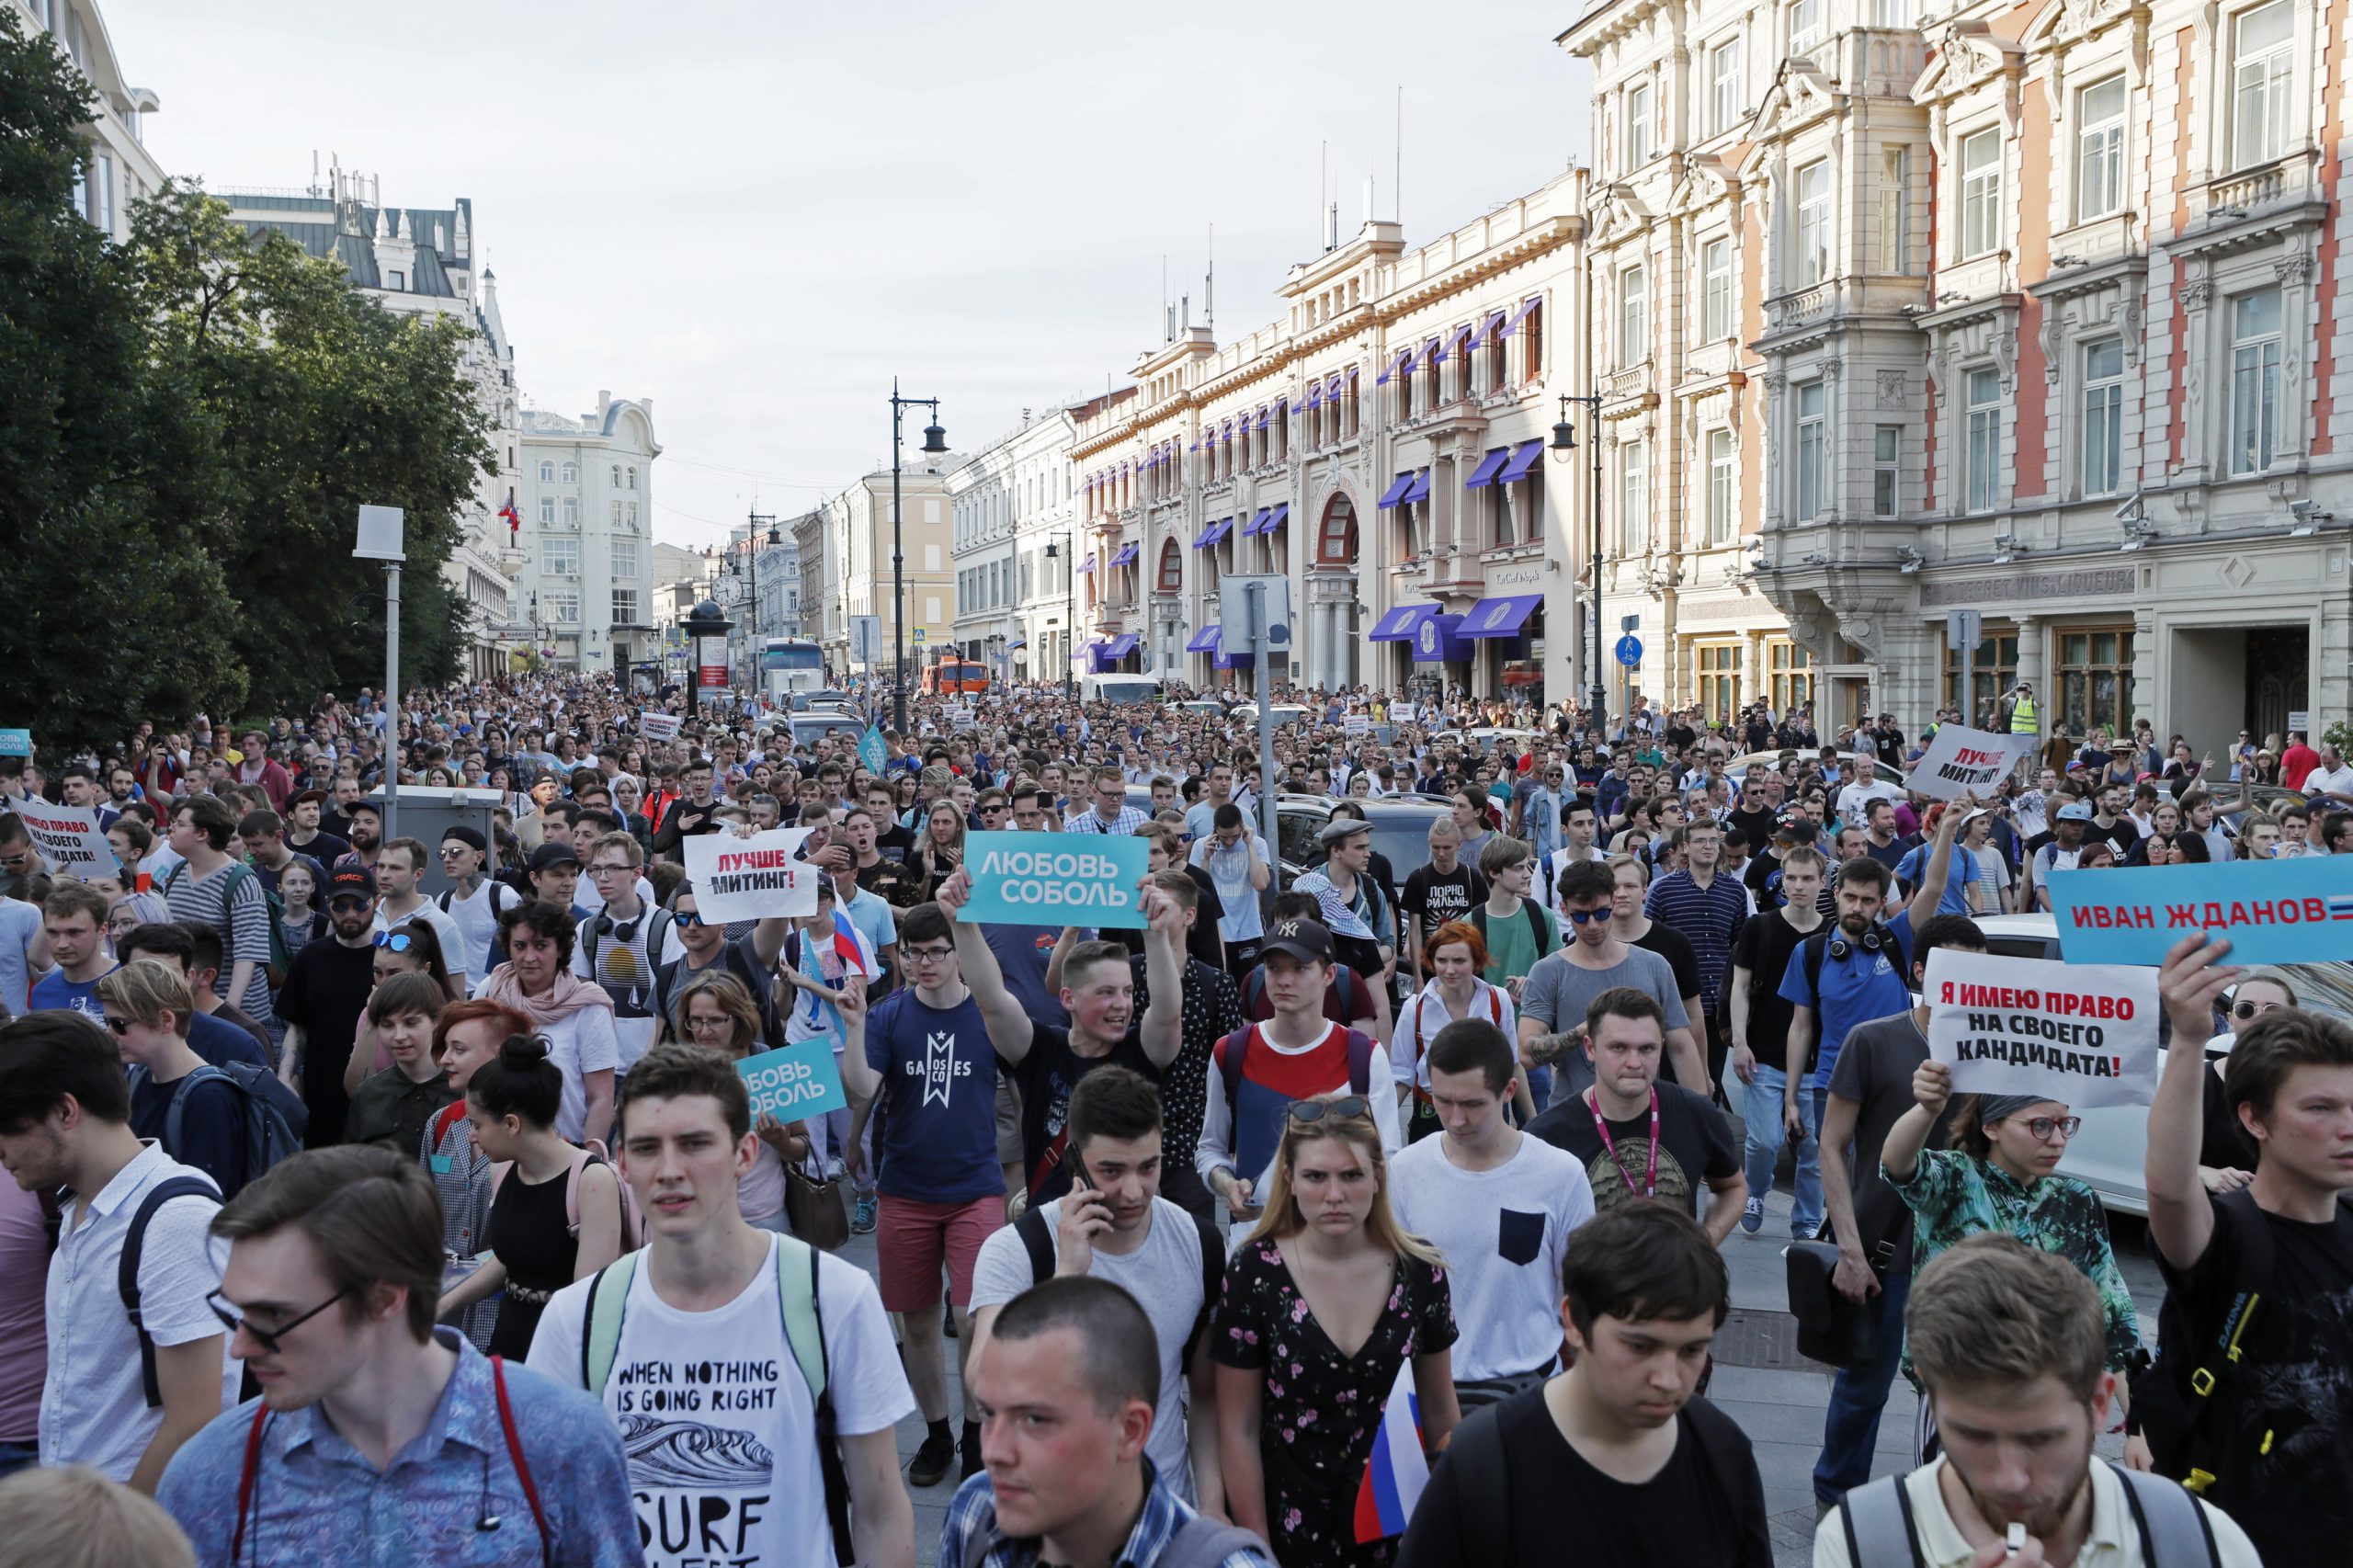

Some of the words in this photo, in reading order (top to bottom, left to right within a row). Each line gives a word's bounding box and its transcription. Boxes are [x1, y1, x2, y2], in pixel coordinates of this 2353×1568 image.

[50, 820, 89, 833] ПРАВО
[718, 849, 786, 872] ЛУЧШЕ
[981, 851, 1119, 880] ЛЮБОВЬ
[710, 870, 795, 895] МИТИНГ!
[1000, 879, 1129, 906] СОБОЛЬ
[1429, 884, 1464, 898] ПОРНО
[2071, 904, 2155, 929] ИВАН
[2165, 897, 2327, 930] ЖДАНОВ
[1278, 921, 1299, 937] NY
[1940, 981, 1954, 1005] Я
[1960, 983, 2040, 1010] ИМЕЮ
[2045, 992, 2134, 1021] ПРАВО
[1968, 1013, 2004, 1033] НА
[2008, 1015, 2104, 1048] СВОЕГО
[1956, 1038, 2120, 1078] КАНДИДАТА!
[741, 1061, 813, 1093] БОВЬ
[749, 1079, 826, 1115] ОБОЛЬ
[620, 1361, 673, 1385] WHEN
[685, 1360, 779, 1384] NOTHING
[618, 1390, 634, 1413] IS
[642, 1389, 701, 1412] GOING
[711, 1387, 778, 1412] RIGHT
[633, 1492, 771, 1555] SURF
